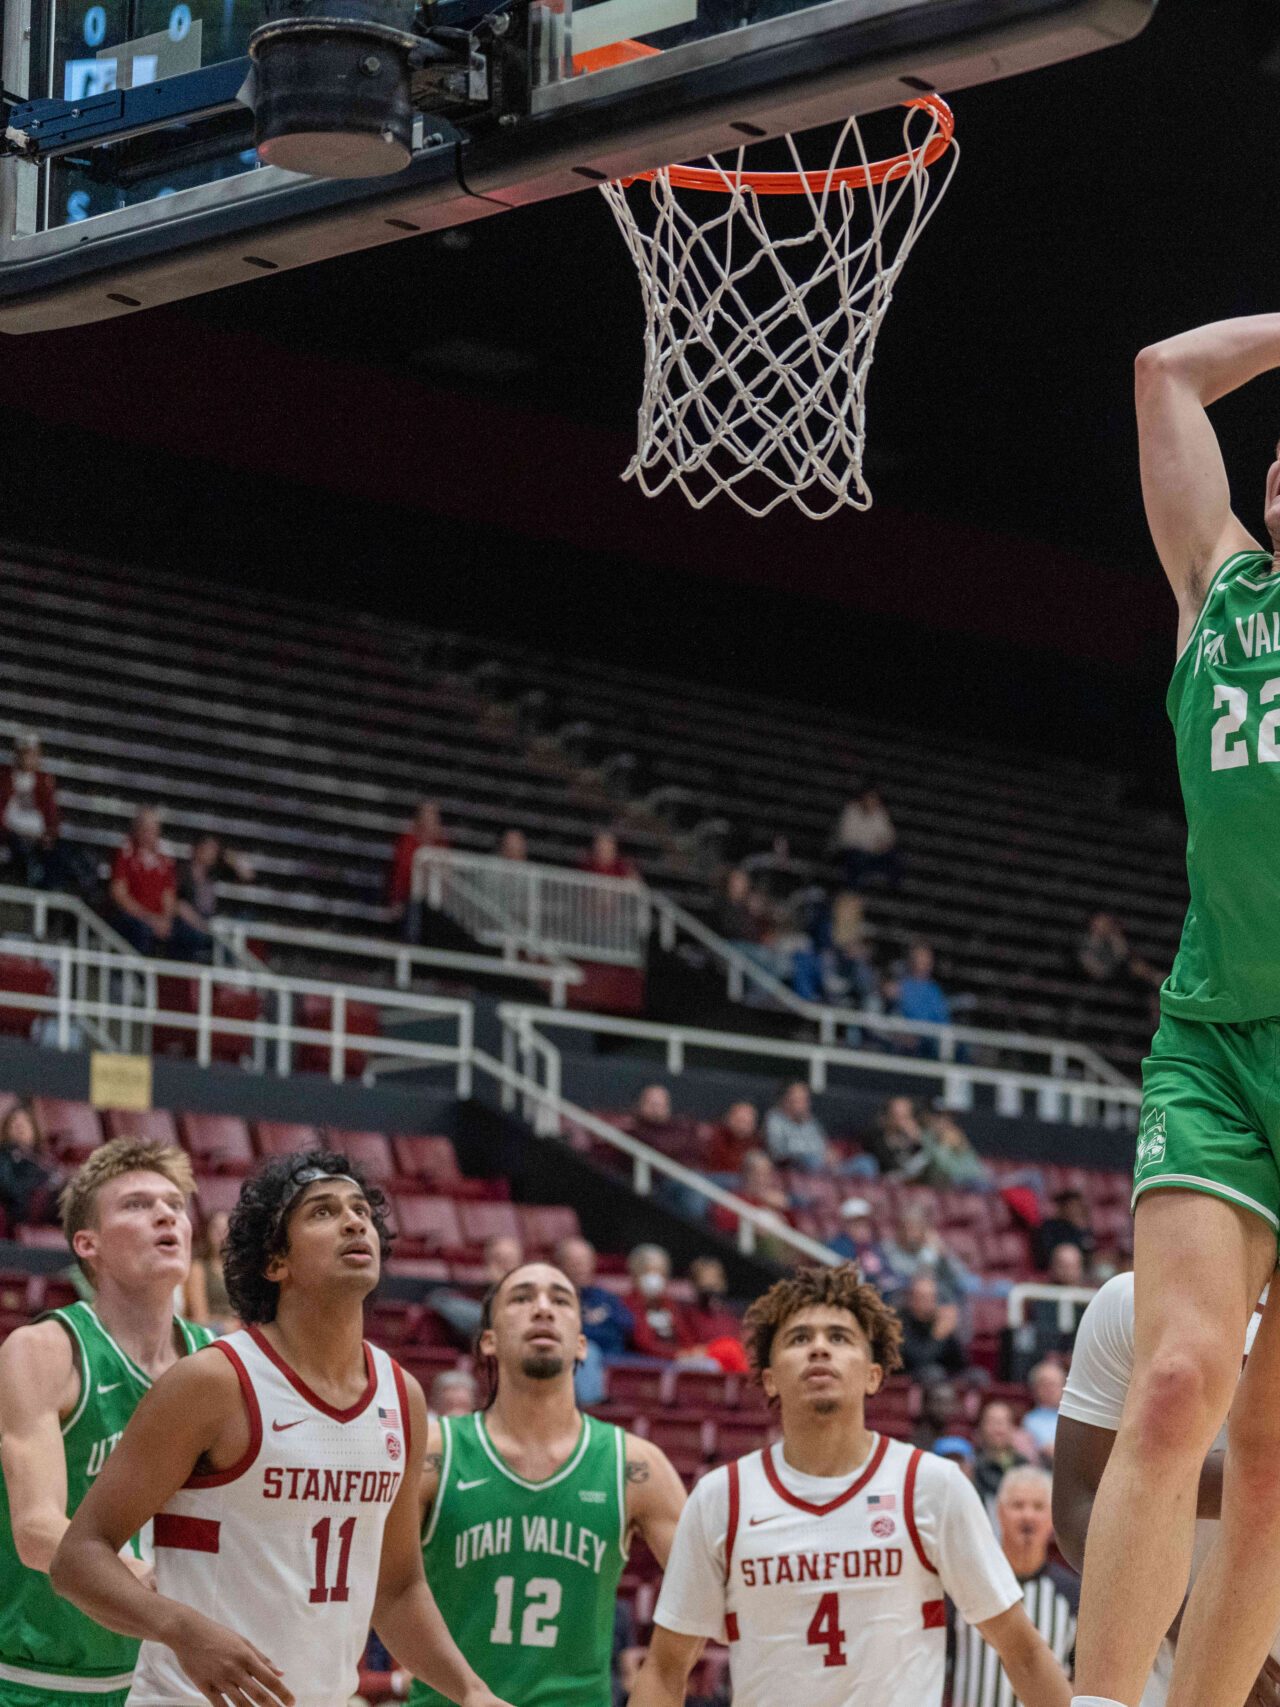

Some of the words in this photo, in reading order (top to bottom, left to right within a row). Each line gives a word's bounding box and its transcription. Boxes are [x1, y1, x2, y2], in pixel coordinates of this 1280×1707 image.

[309, 1517, 357, 1603] 11
[455, 1516, 512, 1568] UTAH
[521, 1515, 607, 1574] VALLEY
[741, 1548, 904, 1587] STANFORD
[490, 1575, 562, 1647] 12
[807, 1592, 847, 1668] 4
